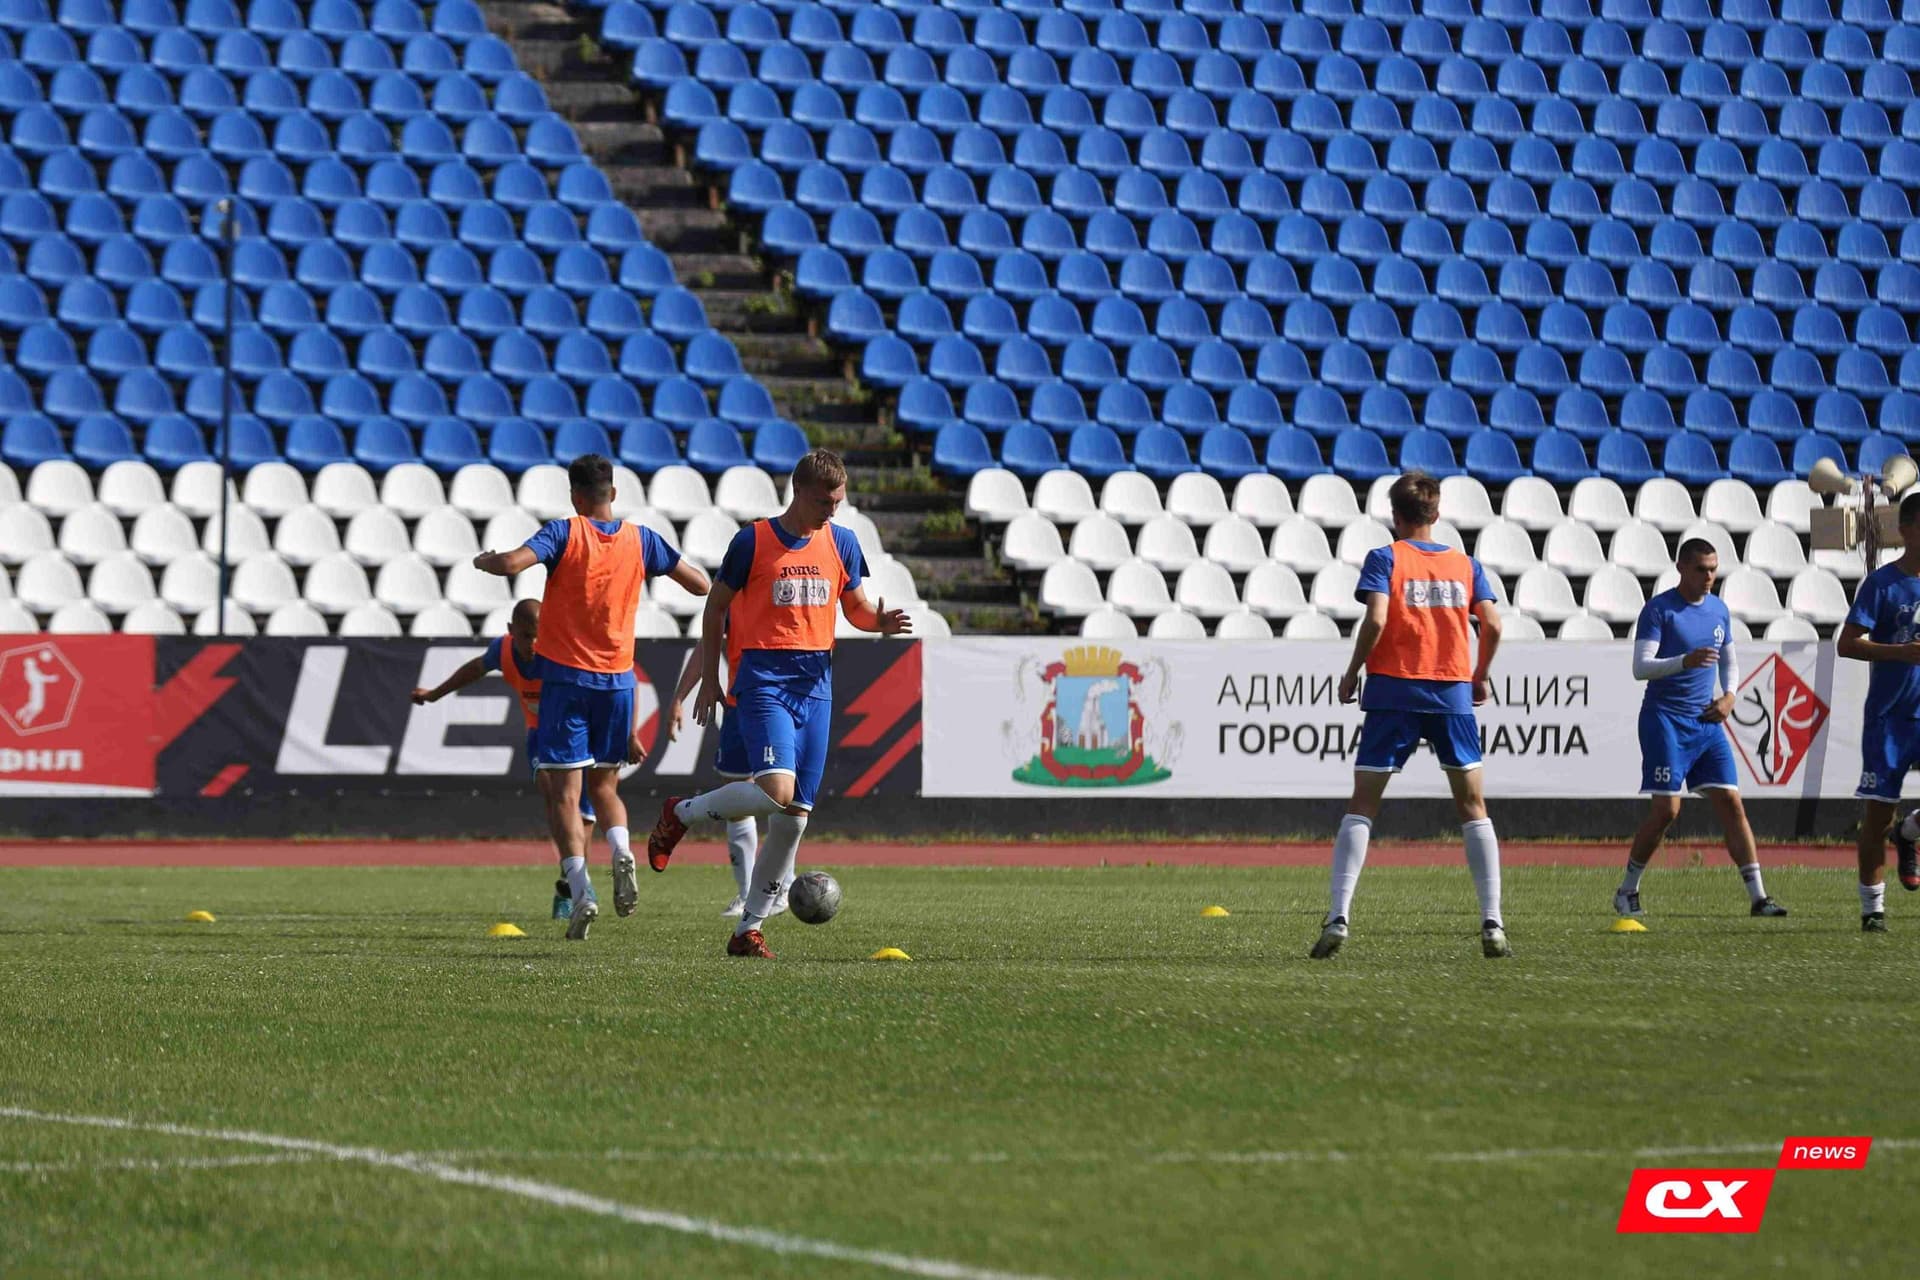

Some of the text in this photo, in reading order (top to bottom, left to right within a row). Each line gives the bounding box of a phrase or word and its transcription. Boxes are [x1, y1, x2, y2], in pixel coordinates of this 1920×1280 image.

[1217, 674, 1588, 714] АДМИАЦИЯ
[763, 744, 776, 765] 4
[1655, 766, 1671, 782] 55
